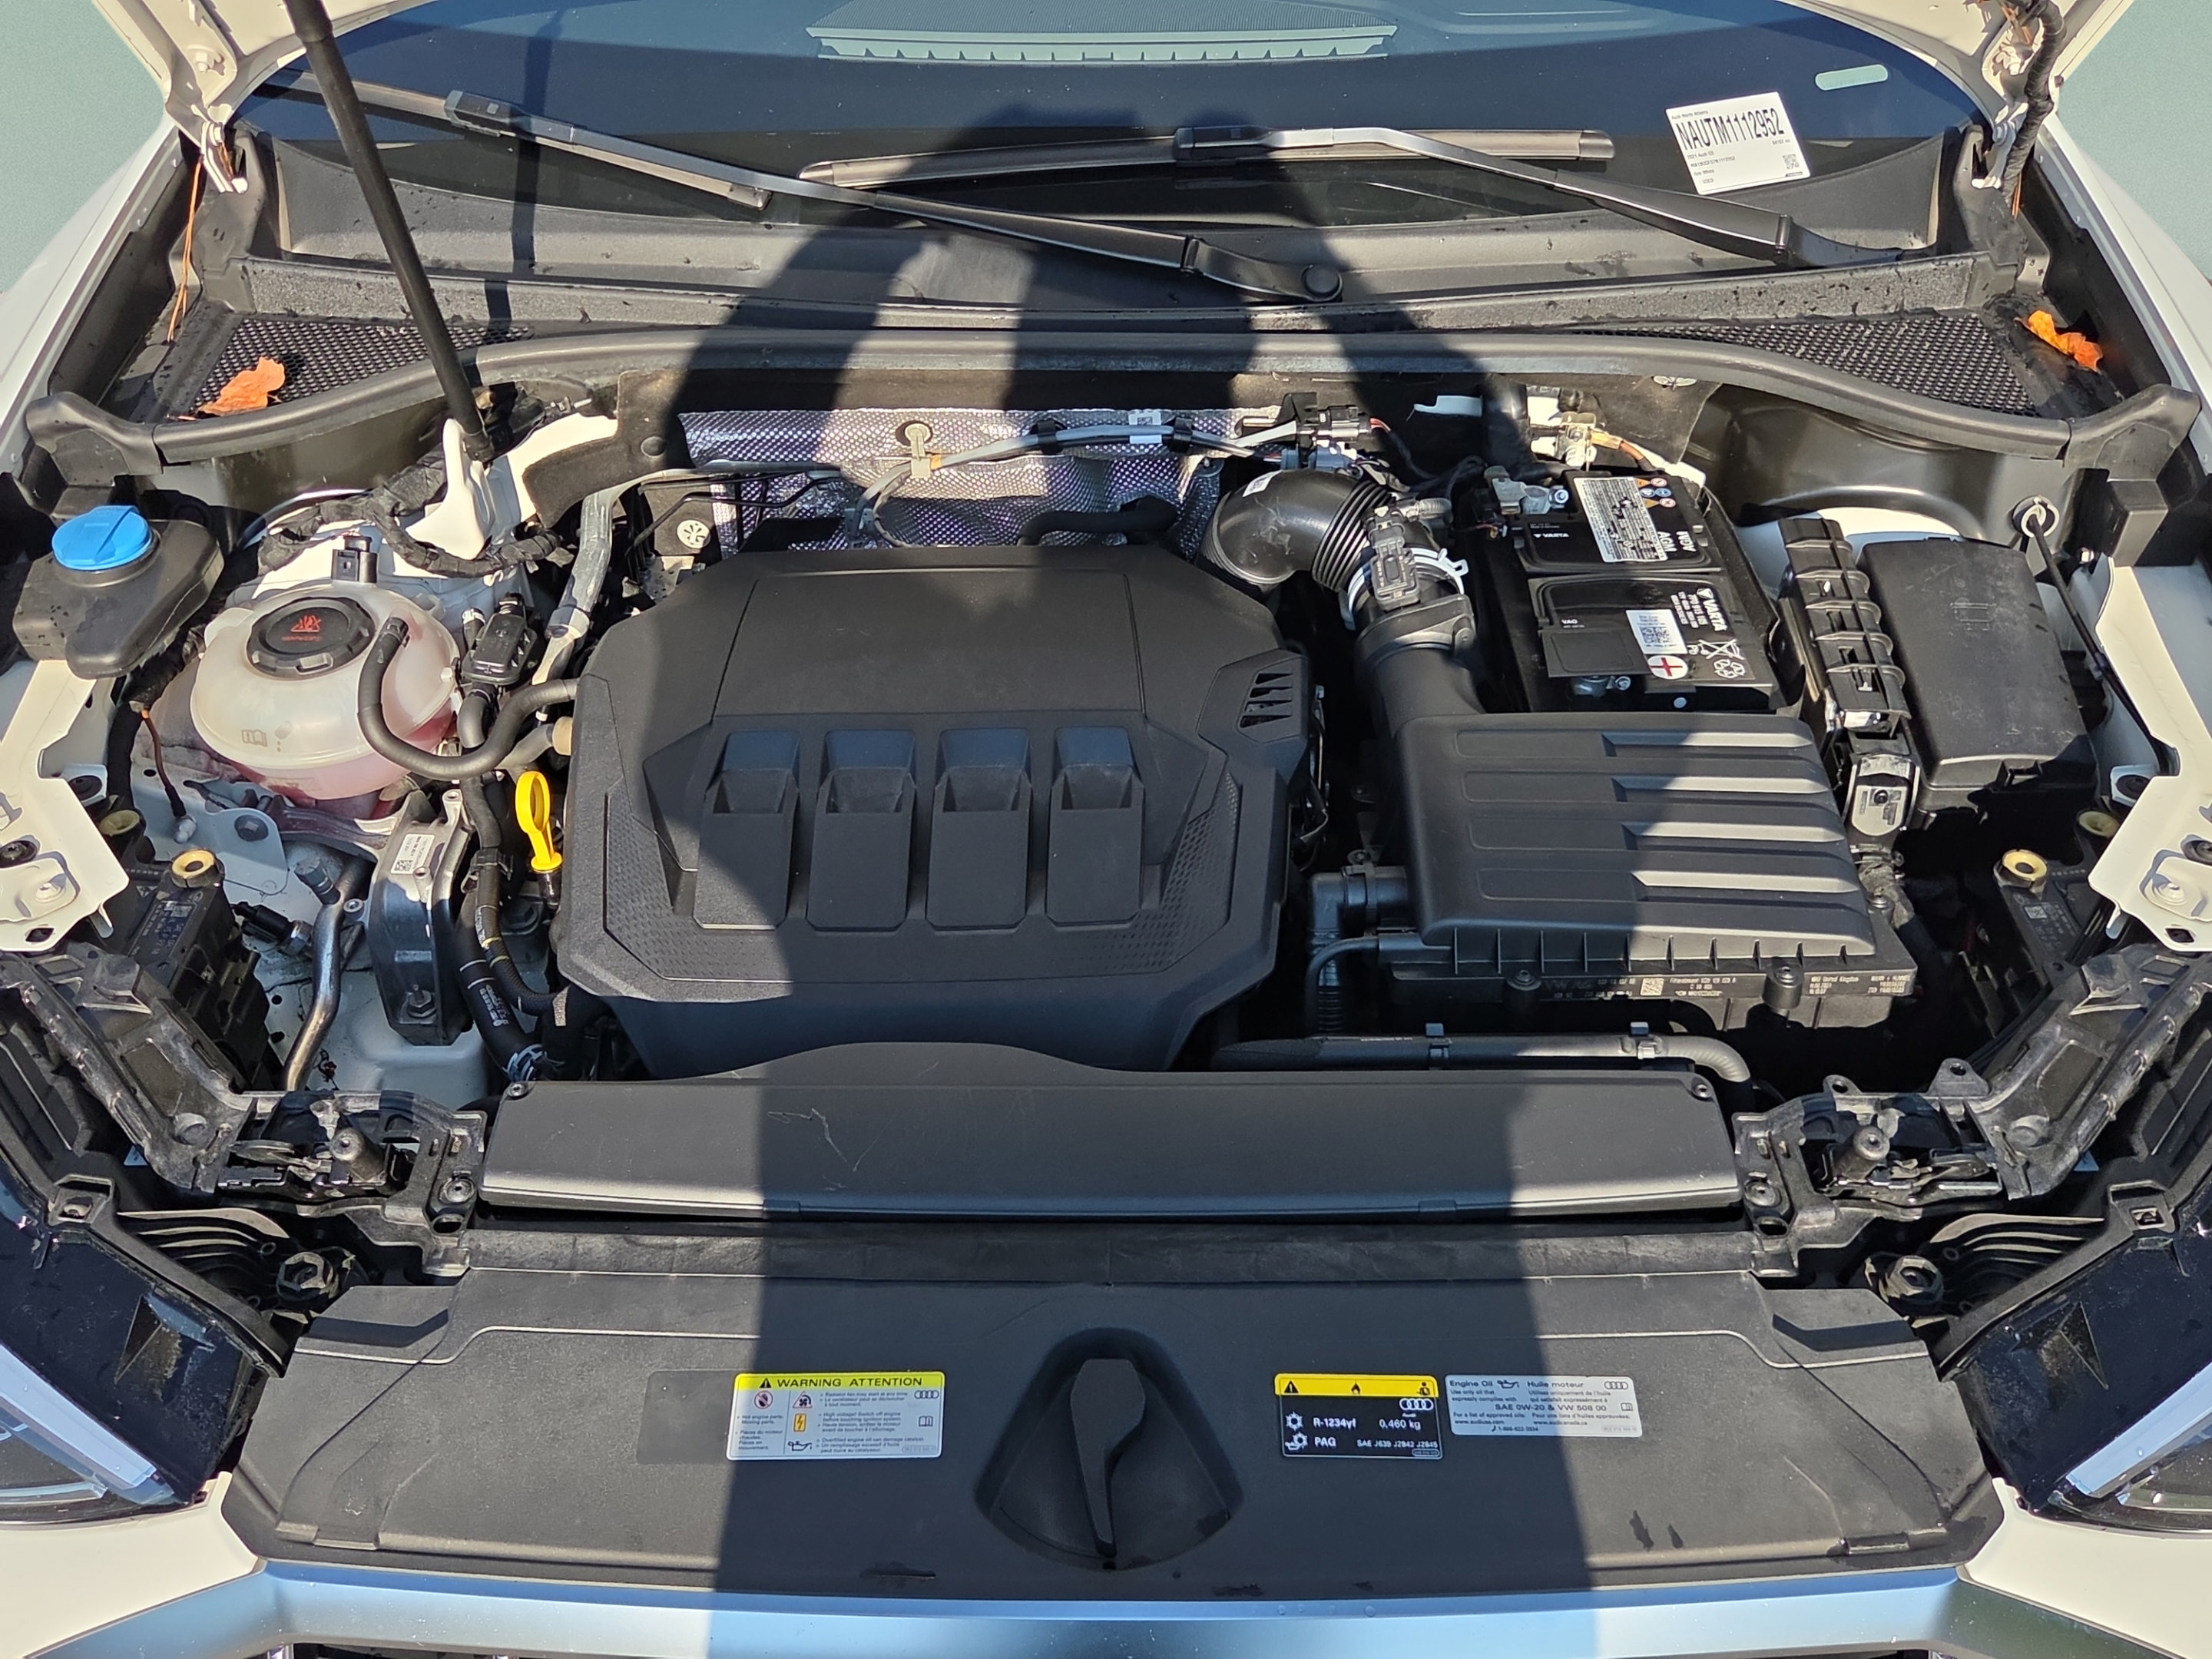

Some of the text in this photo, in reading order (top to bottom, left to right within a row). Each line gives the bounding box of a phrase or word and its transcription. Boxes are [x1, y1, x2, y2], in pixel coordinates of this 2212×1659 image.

[1676, 108, 1785, 151] NAUTM1112952
[1657, 531, 1677, 552] AGM
[1676, 531, 1696, 551] AGM
[1703, 599, 1727, 631] VARTA
[1687, 644, 1699, 655] Pb
[777, 1376, 922, 1388] WARNING ATTENTION
[1313, 1417, 1357, 1432] R-1234yf
[1409, 1419, 1421, 1431] kg
[1313, 1436, 1337, 1448] PAG
[1356, 1439, 1373, 1448] SAE
[1373, 1439, 1392, 1449] J639
[1393, 1439, 1415, 1449] J2842
